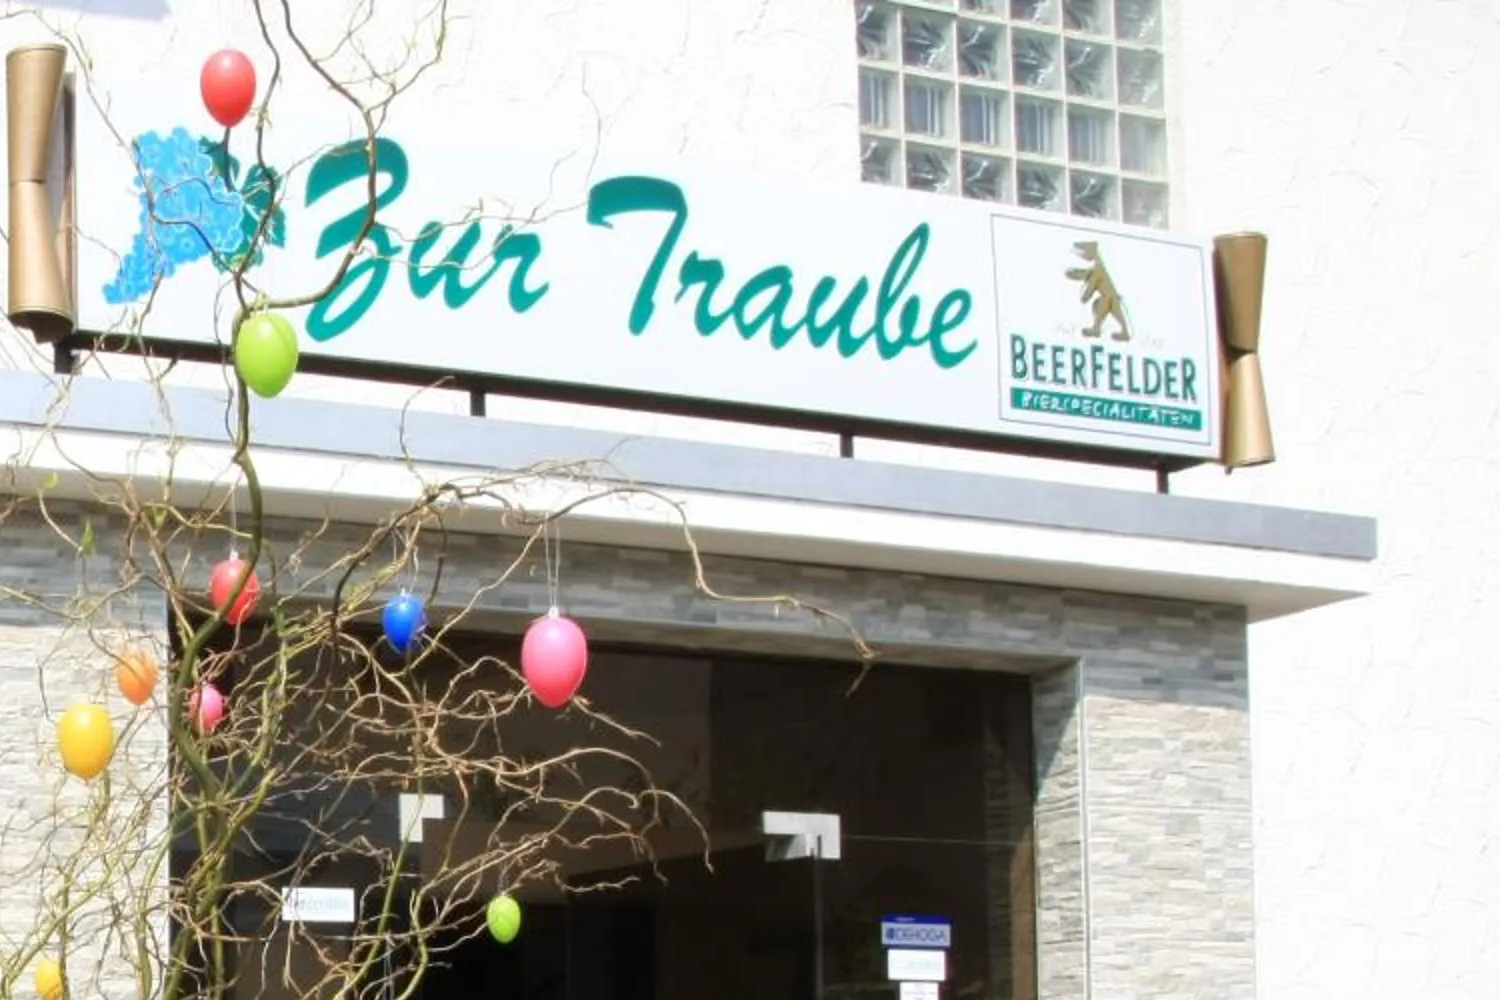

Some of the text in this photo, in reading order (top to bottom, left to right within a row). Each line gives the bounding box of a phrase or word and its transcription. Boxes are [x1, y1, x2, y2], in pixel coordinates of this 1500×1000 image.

[305, 137, 978, 369] Zur Traube
[1010, 333, 1197, 402] BEERFELDER
